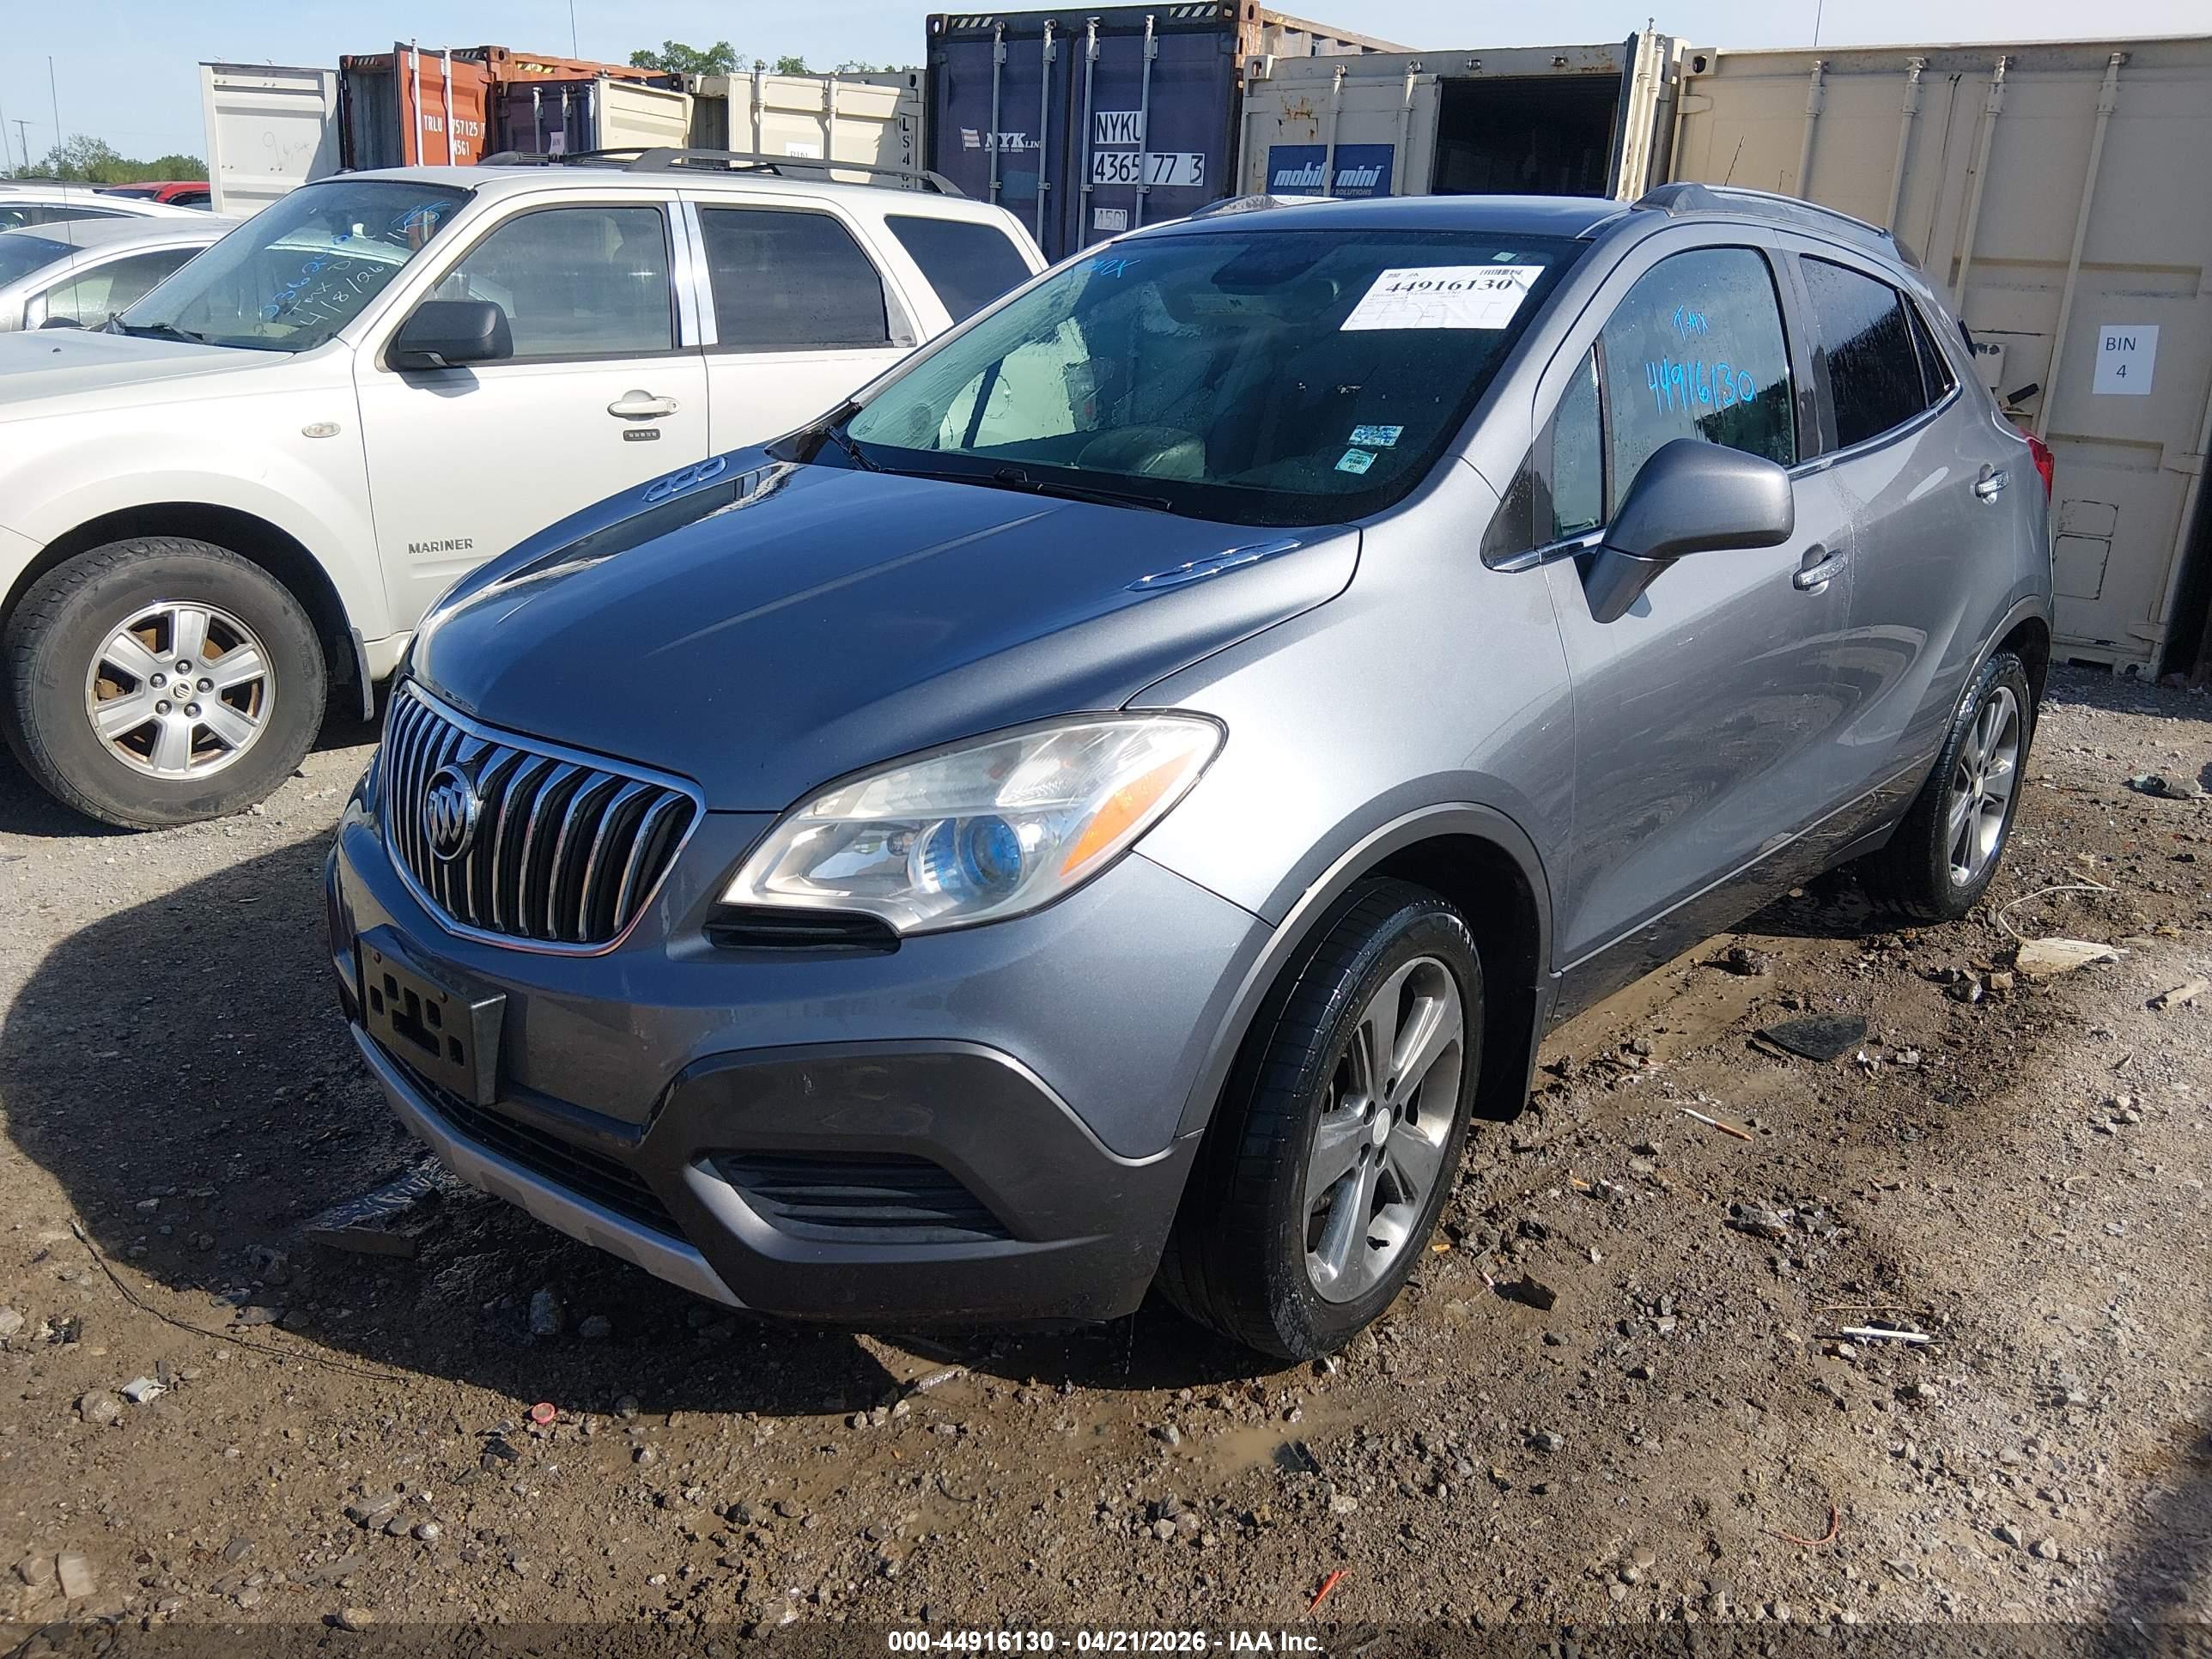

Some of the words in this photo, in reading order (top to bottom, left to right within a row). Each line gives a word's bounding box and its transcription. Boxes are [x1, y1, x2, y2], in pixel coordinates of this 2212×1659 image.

[423, 114, 442, 132] TRLU
[1096, 112, 1142, 142] NYKU
[1024, 140, 1042, 149] LIN
[1336, 165, 1382, 186] mini
[1385, 279, 1513, 293] 44916130
[2106, 337, 2136, 351] BIN
[2116, 364, 2127, 379] 4
[1645, 358, 1755, 415] 44916130
[408, 538, 473, 554] MARINER
